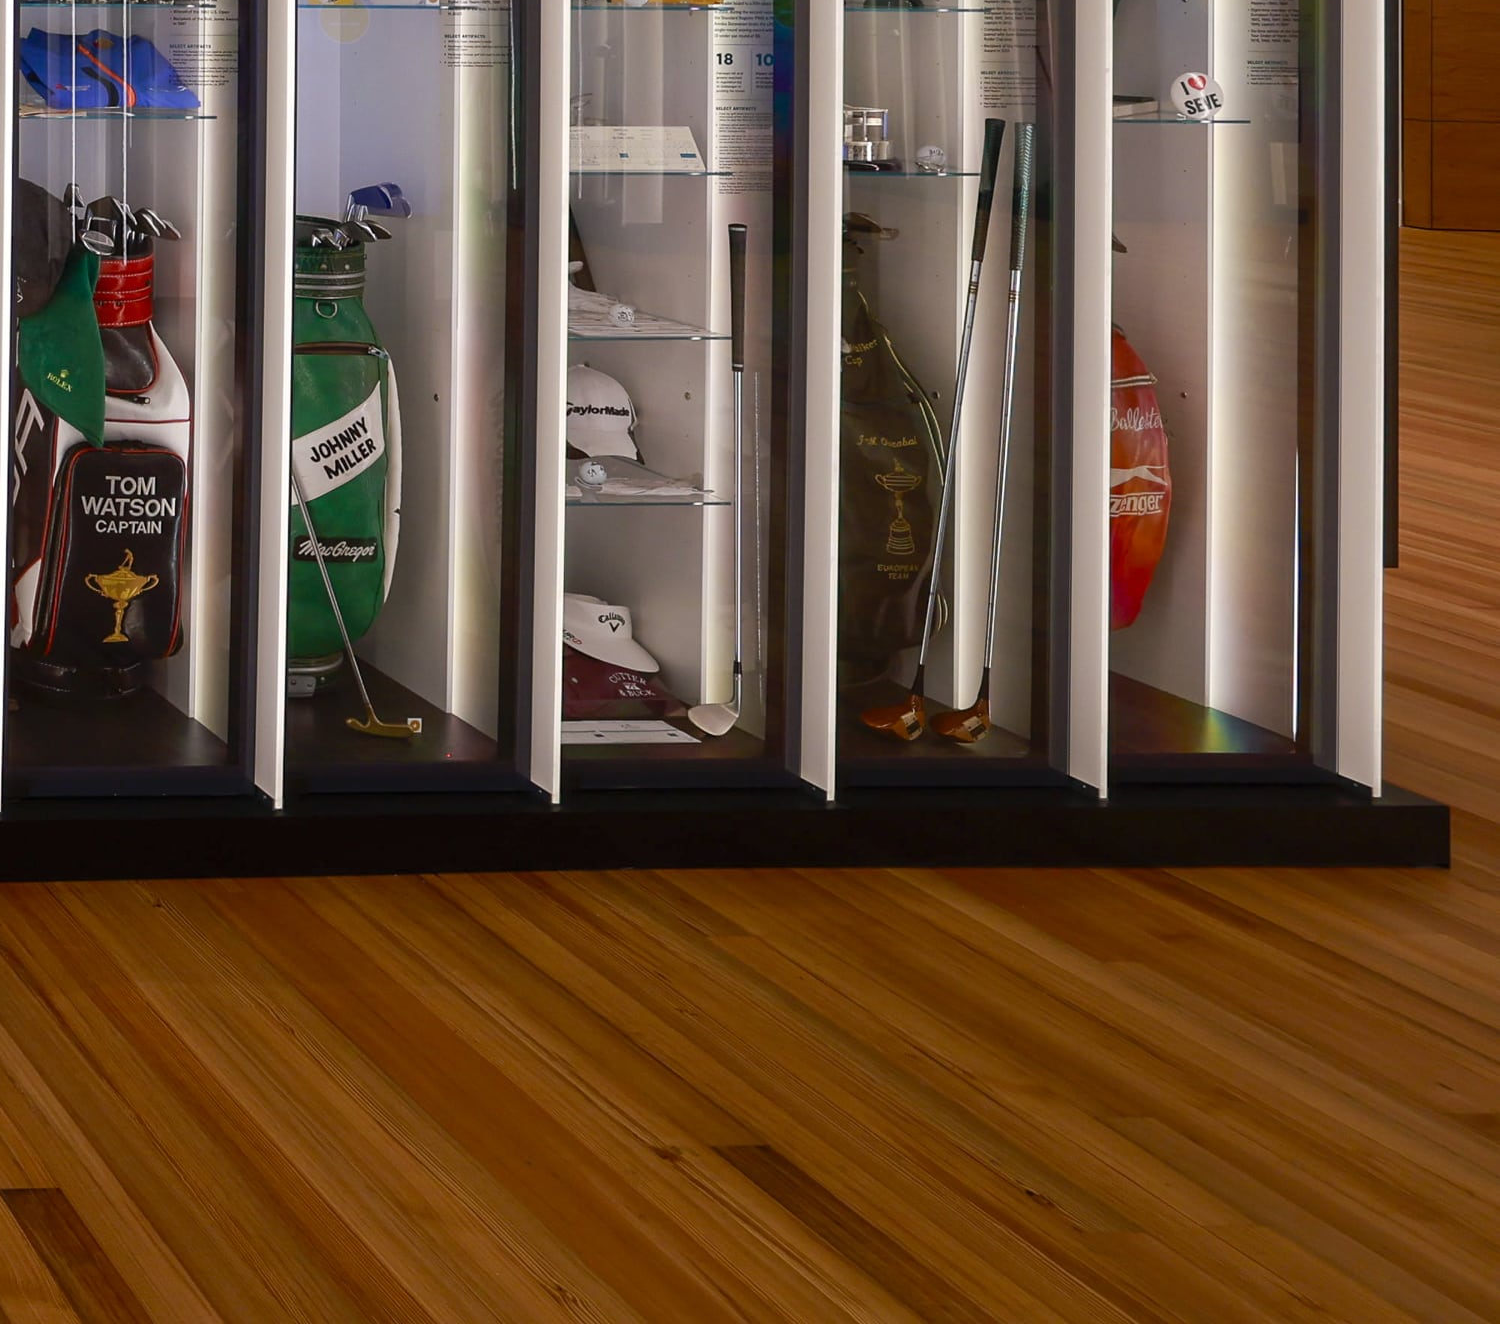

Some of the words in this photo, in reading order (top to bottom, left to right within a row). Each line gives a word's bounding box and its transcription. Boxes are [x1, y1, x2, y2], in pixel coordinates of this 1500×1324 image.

[716, 53, 733, 65] 18
[1180, 81, 1190, 96] I
[1184, 93, 1222, 116] SEVE
[46, 370, 73, 393] ROLEX
[309, 416, 370, 464] JOHNNY
[323, 437, 377, 480] MILLER
[105, 475, 156, 496] TOM
[81, 496, 177, 517] WATSON
[95, 520, 162, 534] CAPTAIN
[608, 672, 648, 686] CUTTER
